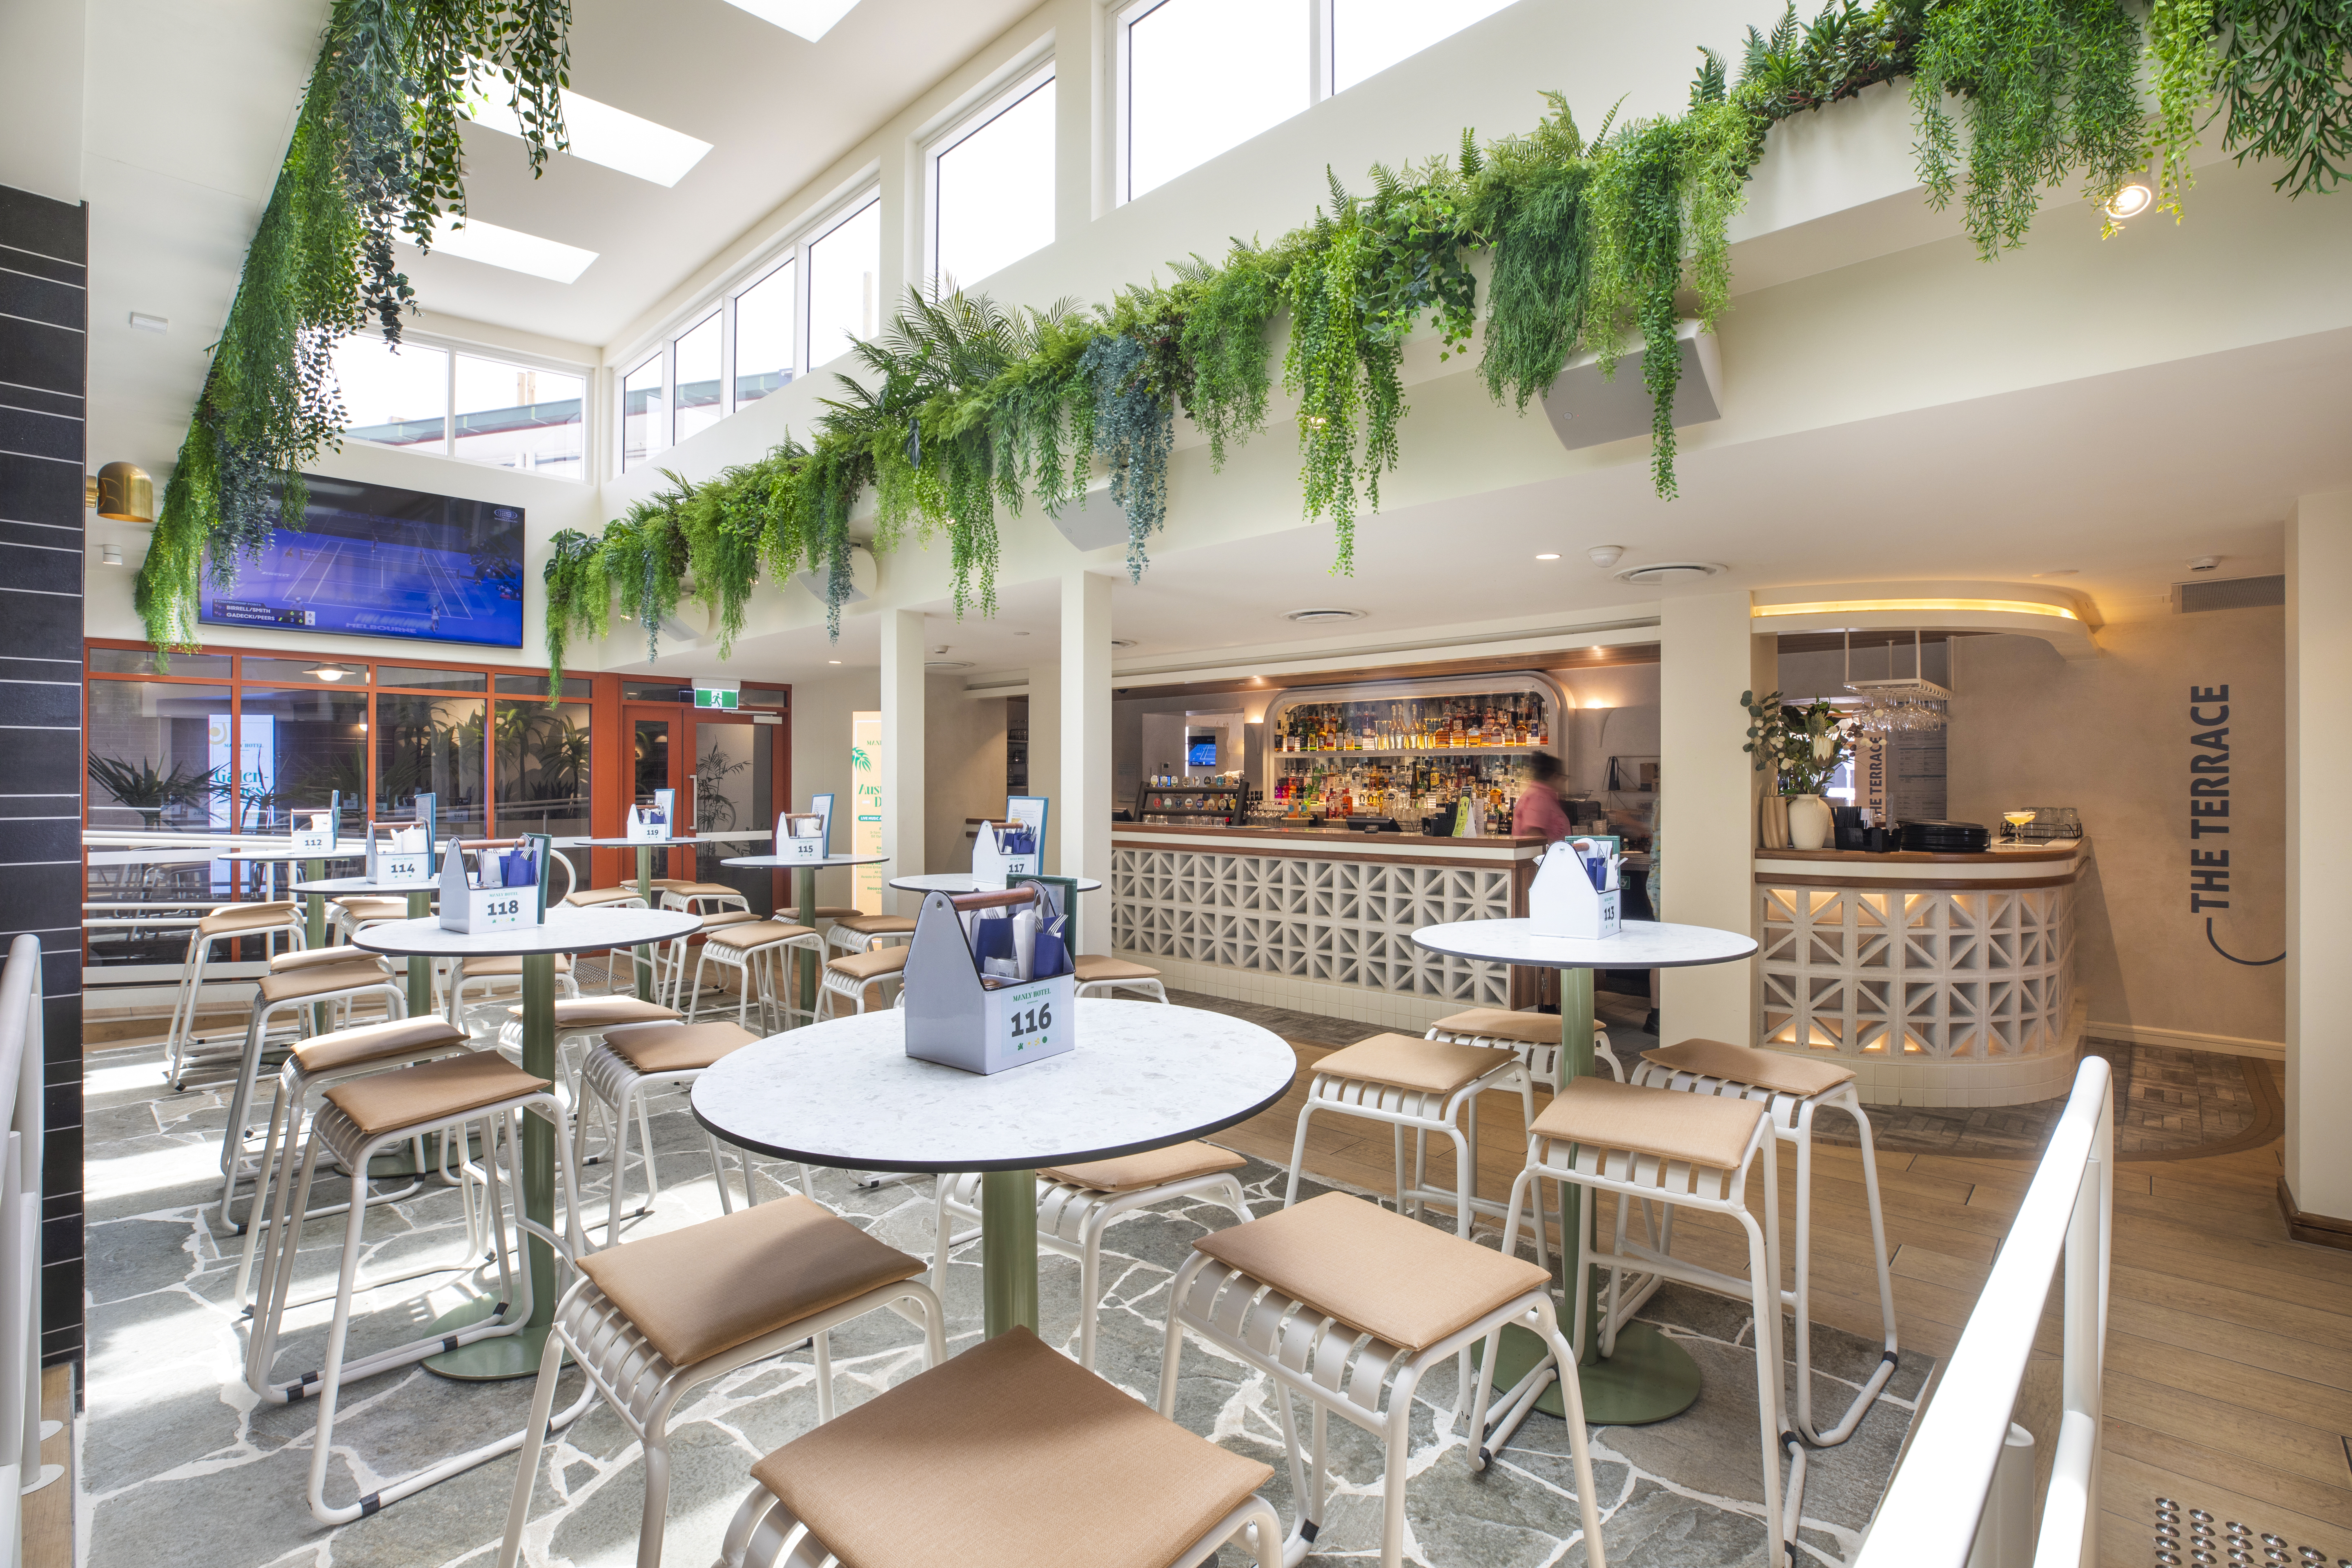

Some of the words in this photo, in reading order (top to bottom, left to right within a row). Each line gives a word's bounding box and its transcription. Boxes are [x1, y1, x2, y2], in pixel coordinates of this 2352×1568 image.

[226, 612, 275, 621] GADECKI/PEERS
[346, 623, 417, 633] MELBOURNE
[1869, 737, 1882, 795] TERRACE
[2190, 684, 2230, 839] TERRACE
[1869, 798, 1882, 814] HE
[391, 863, 415, 873] 114
[1009, 863, 1025, 873] 117
[2191, 849, 2230, 913] THE
[488, 900, 519, 916] 118
[1604, 906, 1615, 921] 113
[1013, 992, 1032, 1002] MANLY
[1033, 988, 1051, 997] HOTEL
[1011, 1002, 1051, 1038] 116
